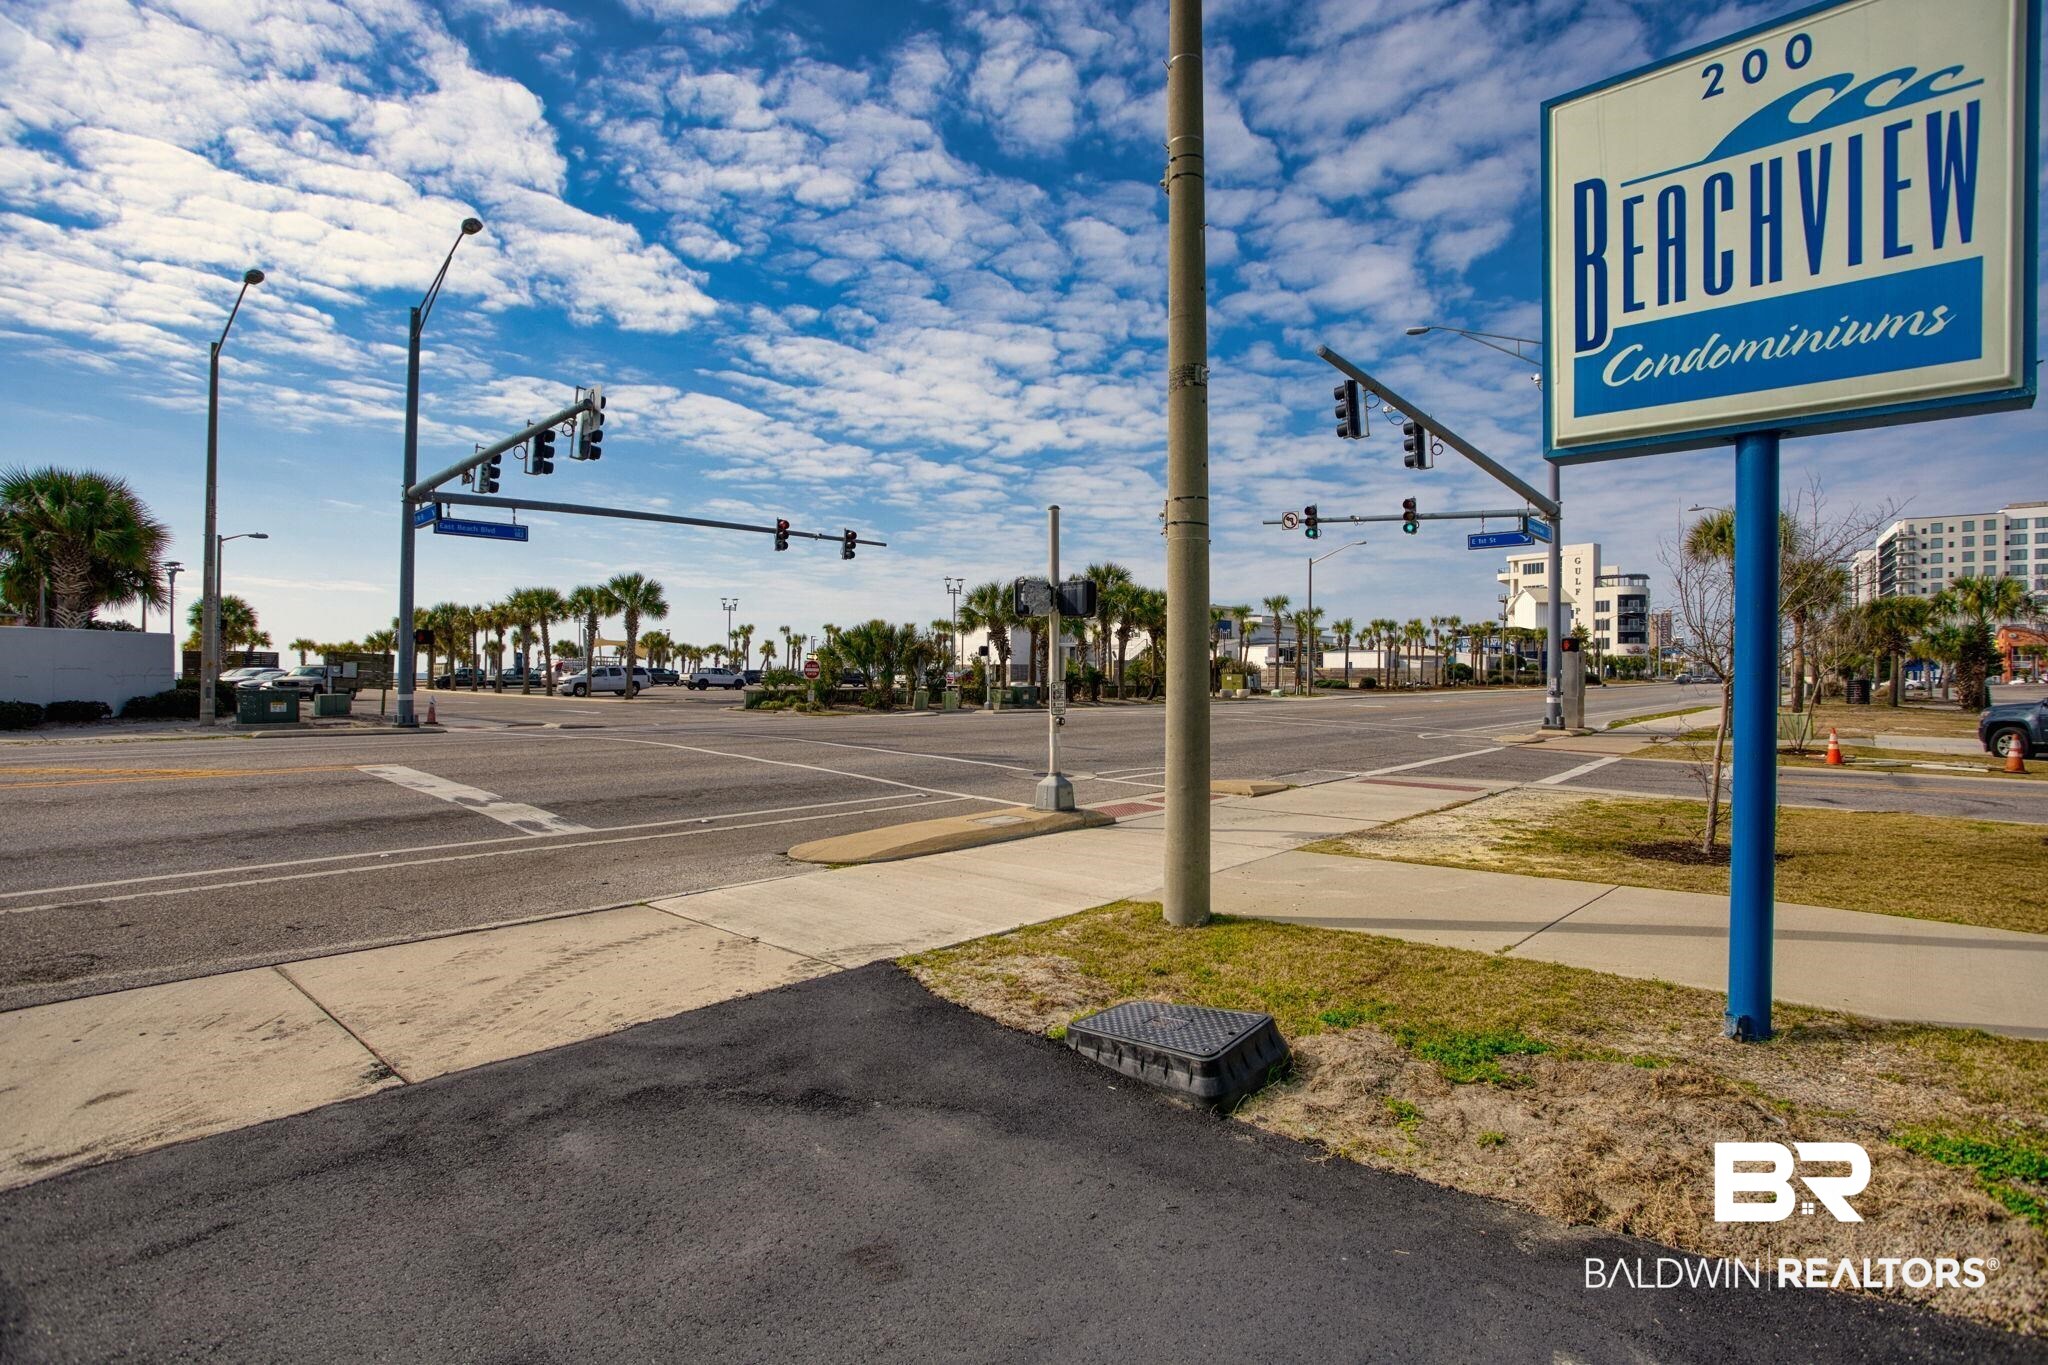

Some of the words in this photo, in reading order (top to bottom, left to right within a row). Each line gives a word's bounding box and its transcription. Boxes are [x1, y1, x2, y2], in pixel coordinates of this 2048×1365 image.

[1702, 33, 1812, 100] 200
[1574, 99, 1980, 354] BEACHVIEW
[1602, 303, 1957, 387] Condominiums
[439, 523, 455, 531] East
[457, 525, 479, 533] Beach
[480, 526, 496, 534] Blvd
